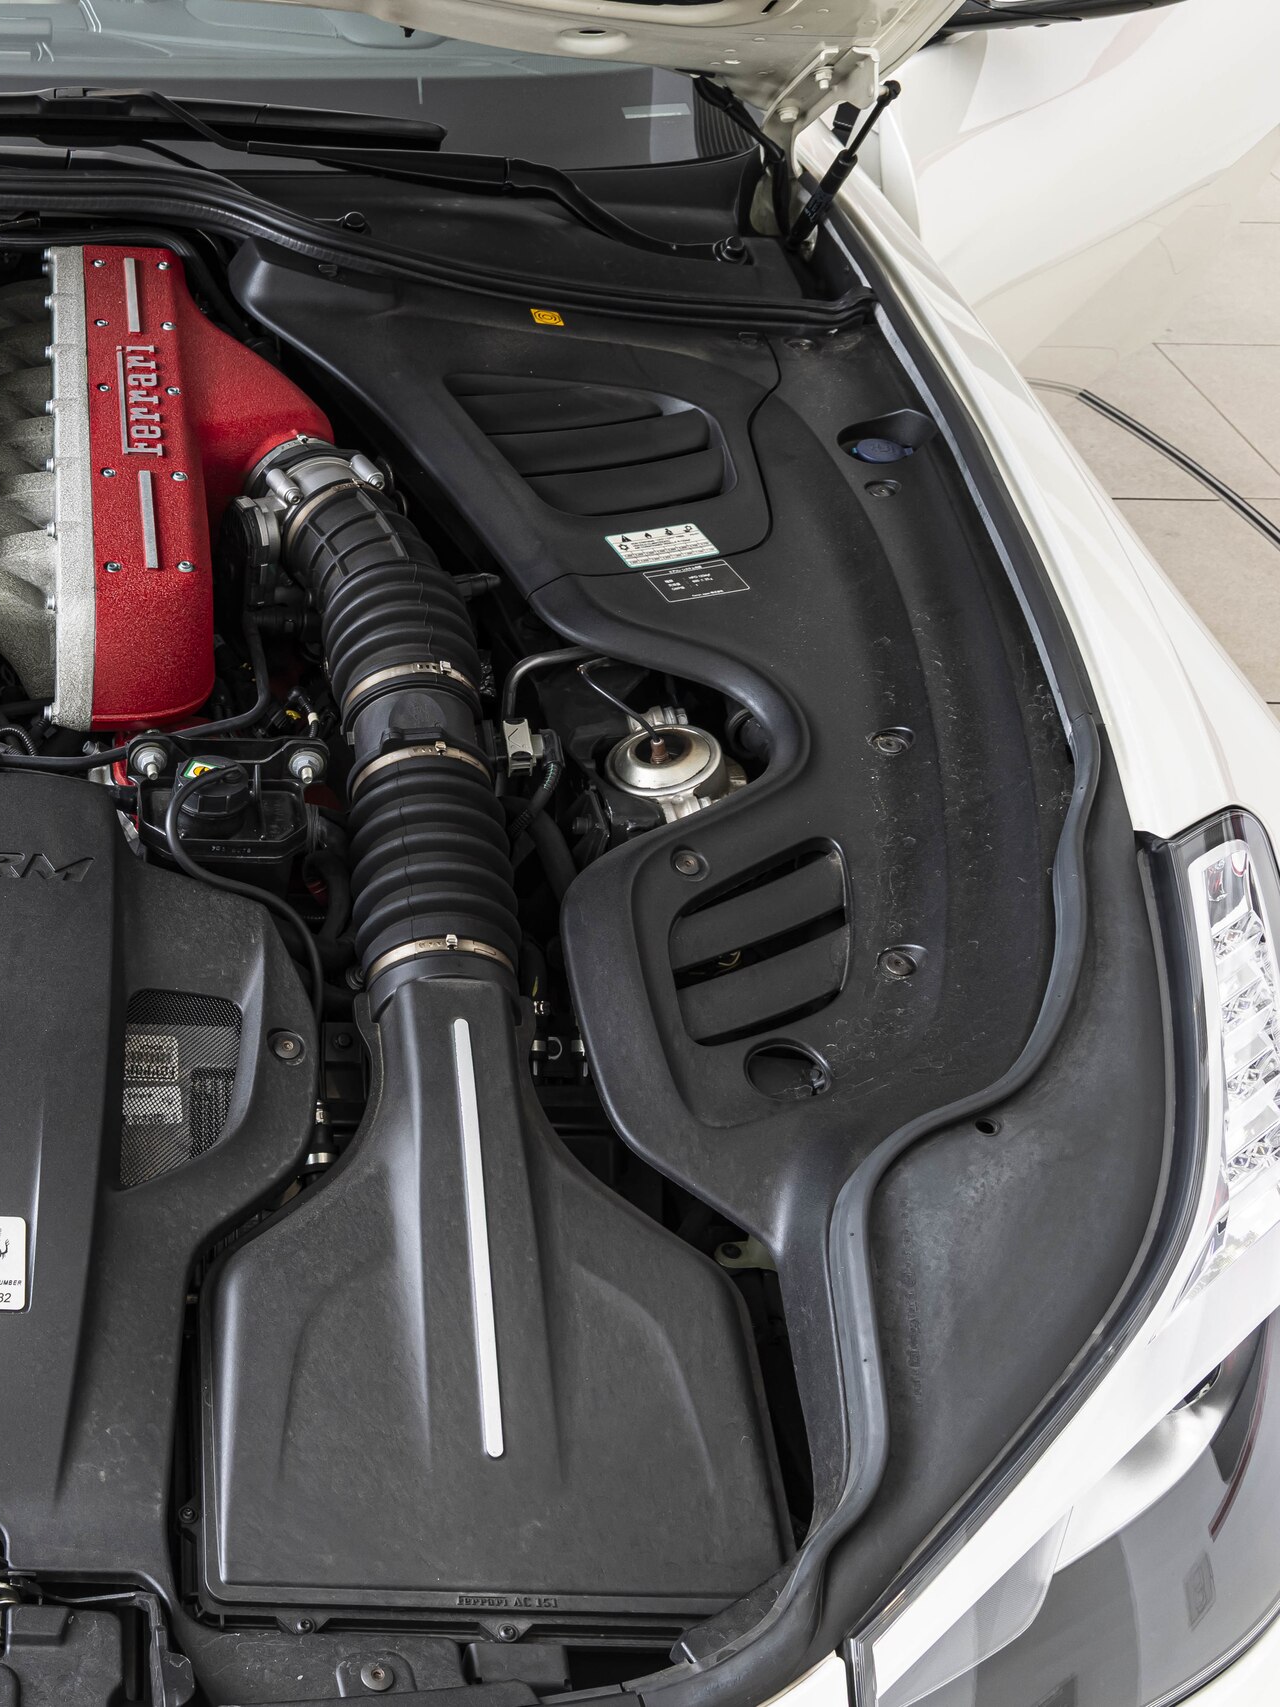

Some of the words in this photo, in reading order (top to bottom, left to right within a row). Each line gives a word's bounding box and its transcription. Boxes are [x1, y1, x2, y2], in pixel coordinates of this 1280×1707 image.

[116, 345, 164, 457] Ferrari
[456, 1595, 509, 1607] Ferrari
[513, 1596, 532, 1608] AC
[535, 1597, 559, 1609] 151
